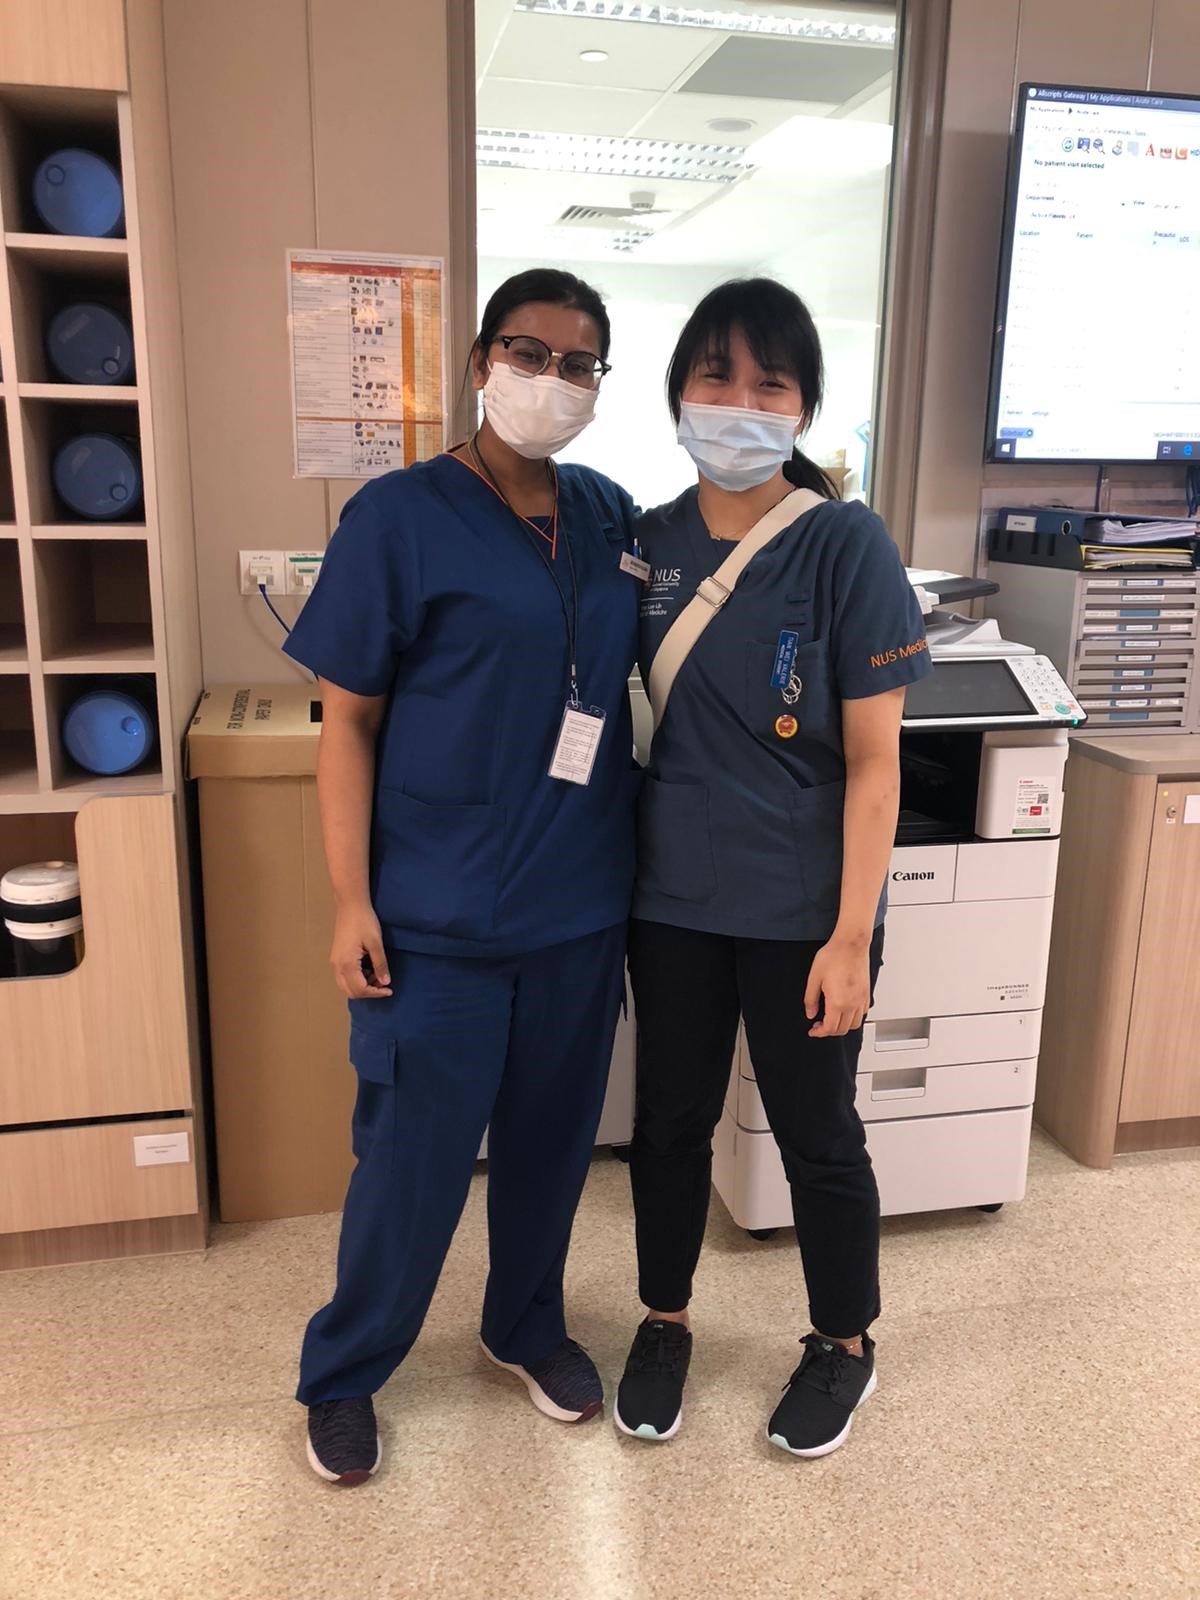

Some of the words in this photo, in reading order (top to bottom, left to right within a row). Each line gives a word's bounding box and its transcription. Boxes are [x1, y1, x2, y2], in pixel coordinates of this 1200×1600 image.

[654, 568, 681, 582] NUS
[870, 649, 897, 669] NUS
[892, 871, 934, 881] Canon
